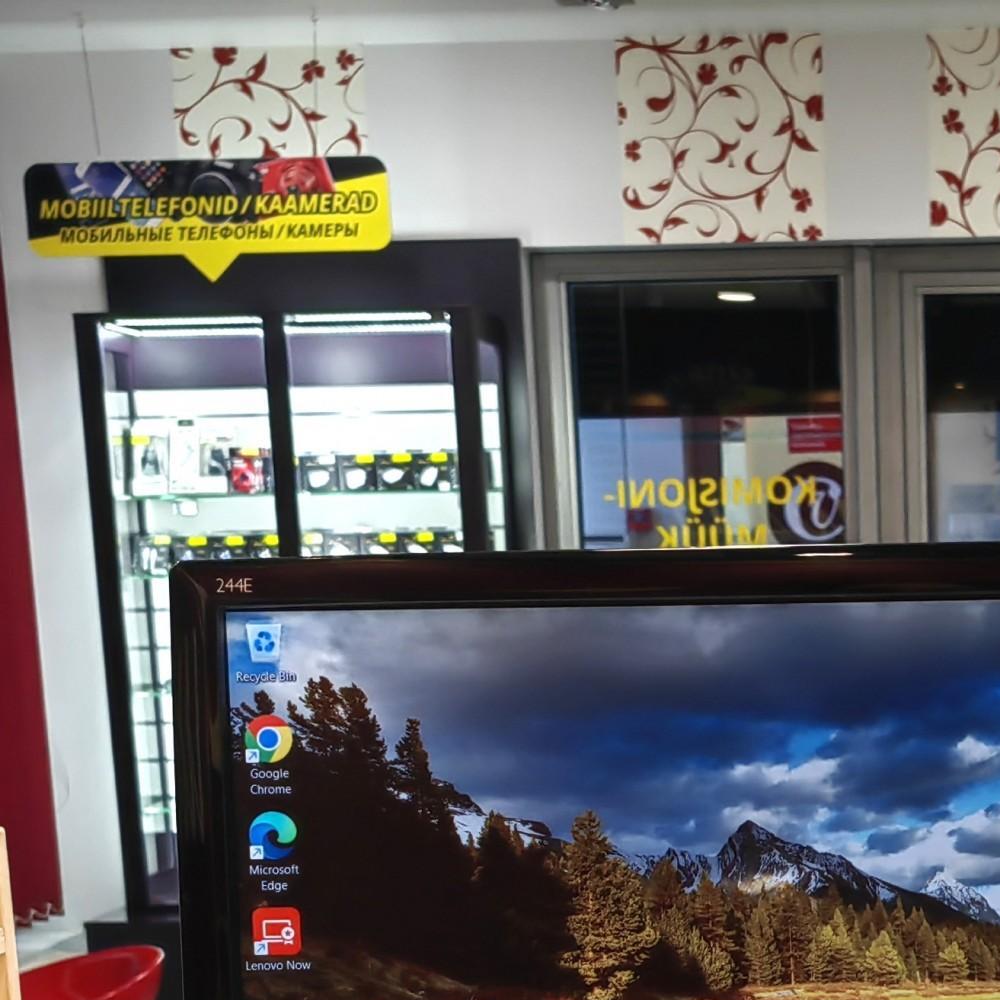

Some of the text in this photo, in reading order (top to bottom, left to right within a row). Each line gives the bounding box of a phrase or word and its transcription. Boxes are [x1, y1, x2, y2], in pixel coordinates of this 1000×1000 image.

[60, 226, 174, 243] МОБИЛЬНЫЕ
[215, 577, 253, 593] 244E
[236, 671, 297, 683] Recycle Bin
[250, 768, 290, 780] Google
[250, 784, 292, 795] Chrome
[249, 864, 300, 875] Microsoft
[261, 880, 289, 892] Edge
[245, 960, 311, 971] Lenovo Now
